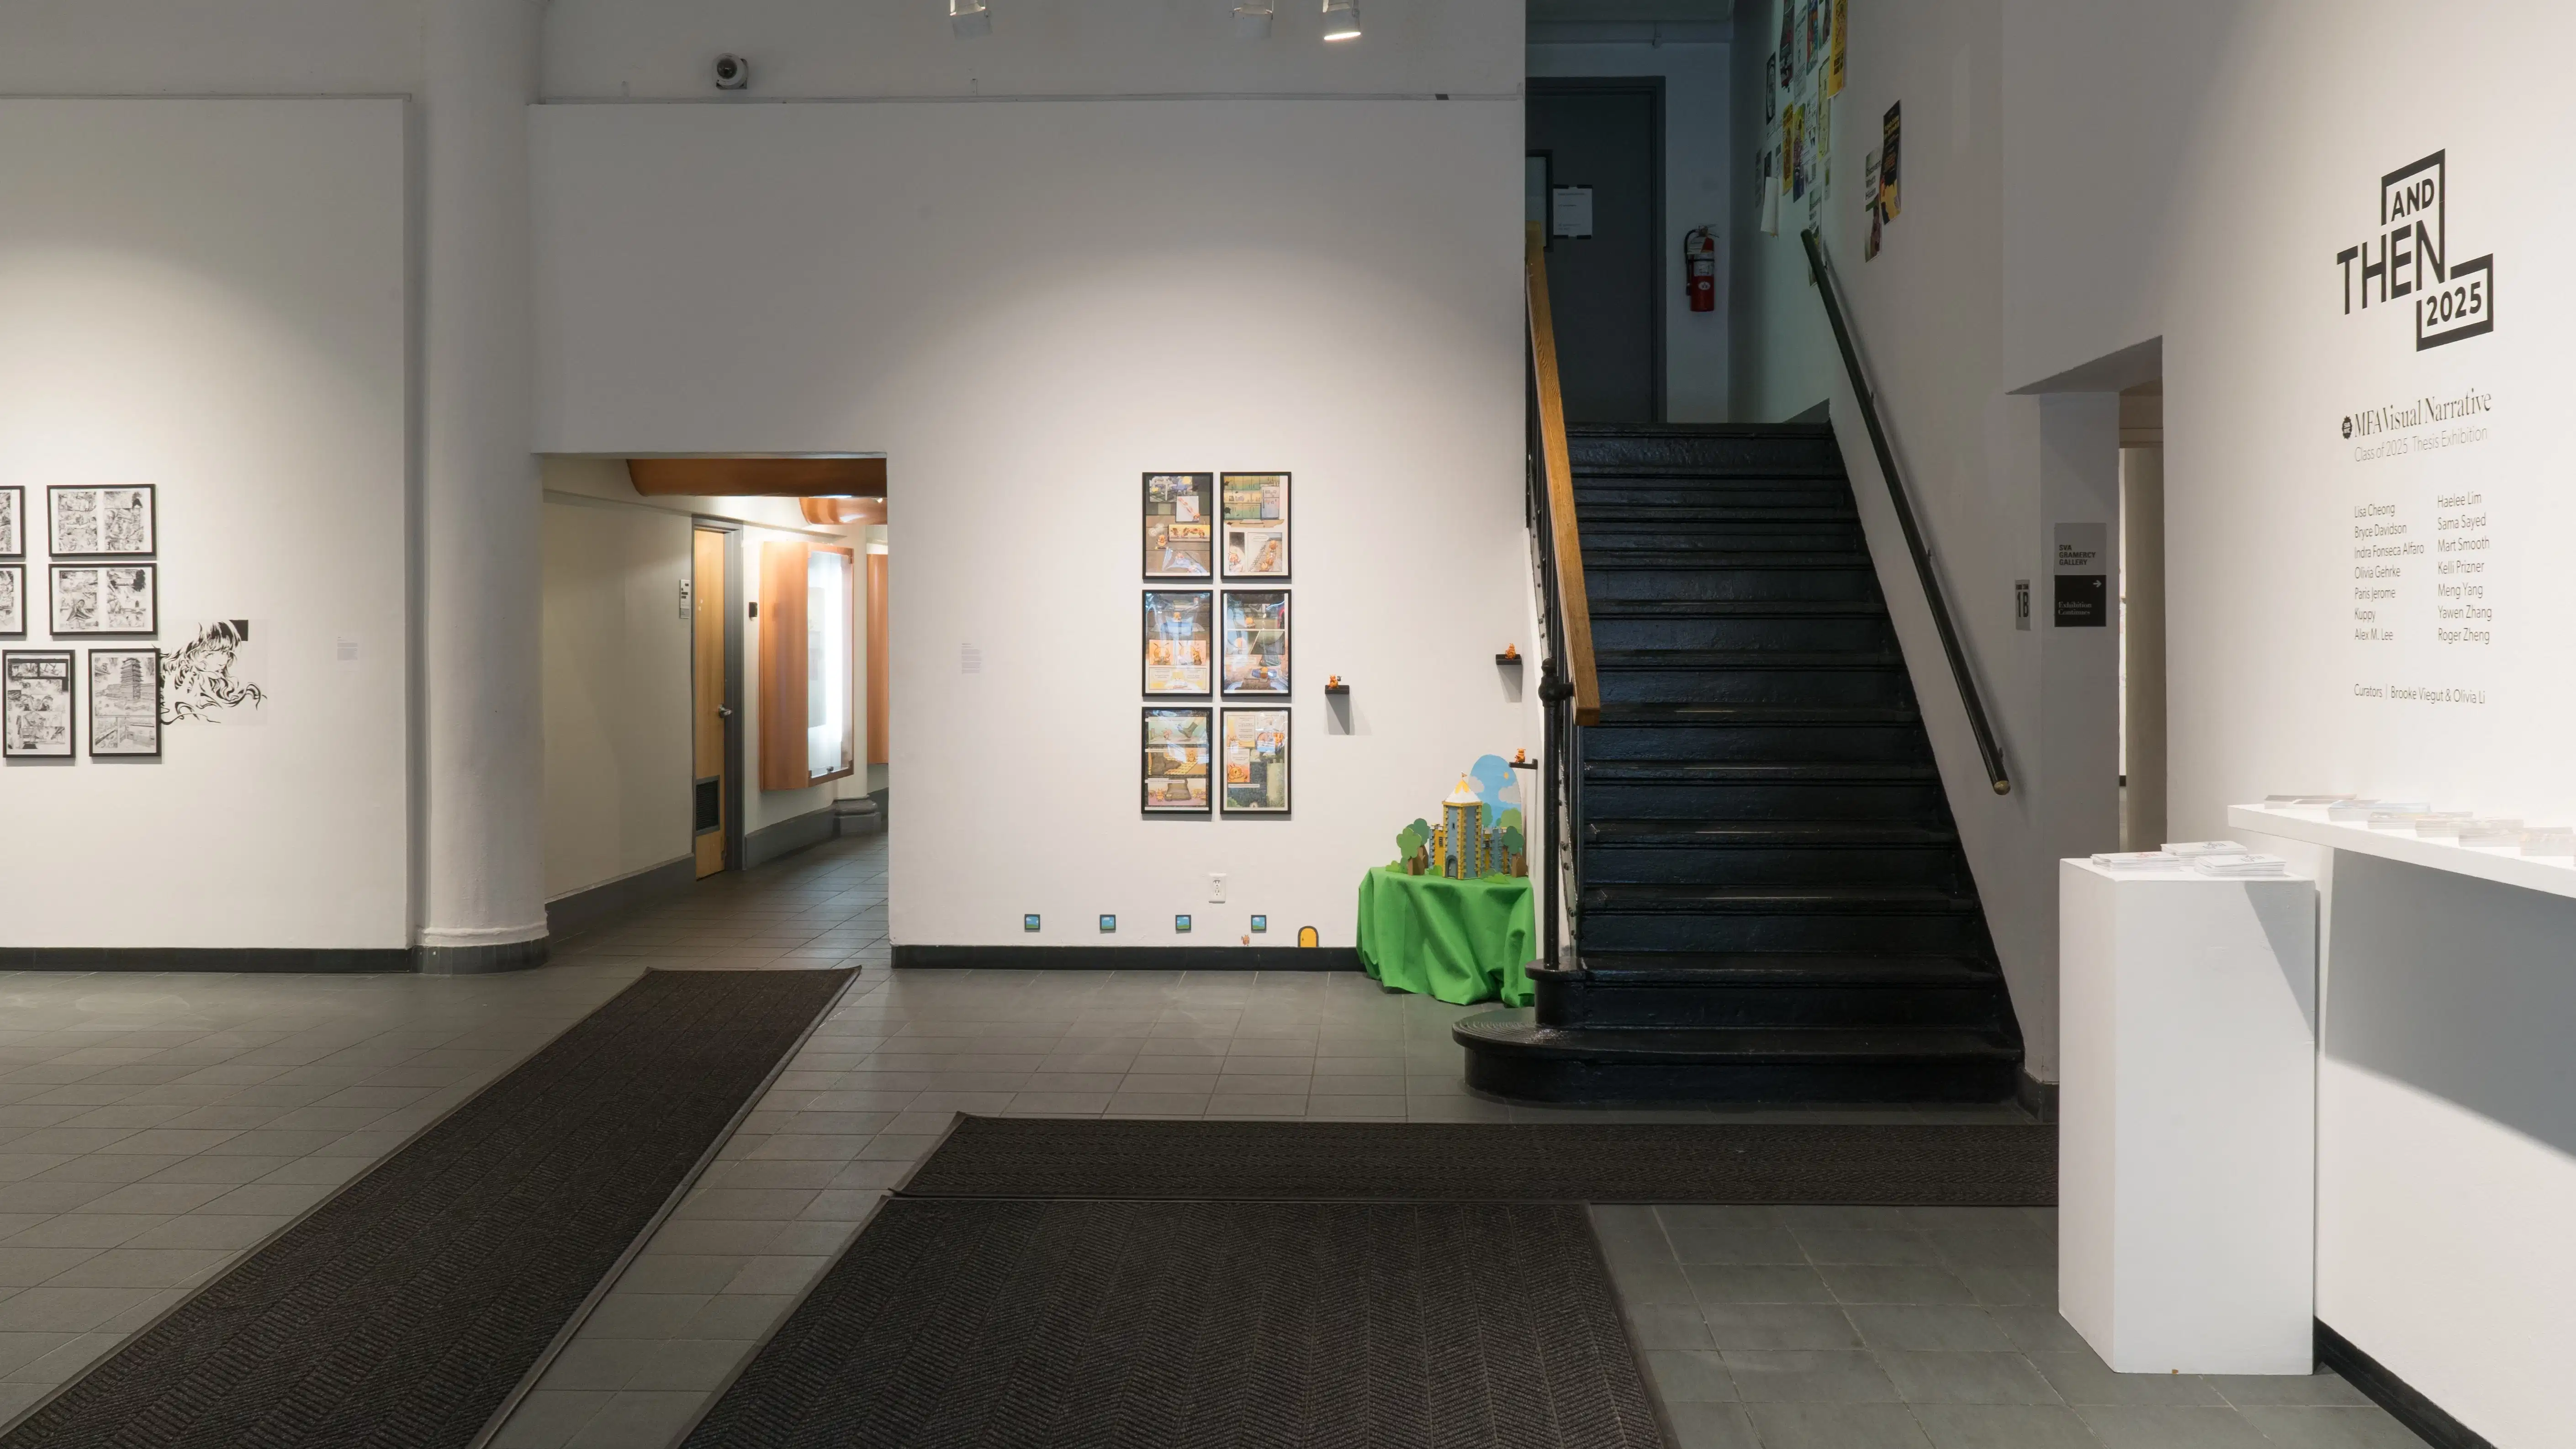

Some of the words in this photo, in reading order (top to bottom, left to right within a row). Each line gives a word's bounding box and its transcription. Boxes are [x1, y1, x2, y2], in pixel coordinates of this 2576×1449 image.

[2391, 178, 2434, 222] AND
[2337, 220, 2445, 315] THEN
[2426, 281, 2482, 327] 2025
[2354, 409, 2382, 438] MFA
[2382, 399, 2421, 430] Visual
[2424, 388, 2491, 423] Narrative
[2354, 446, 2375, 462] Class
[2376, 442, 2385, 458] of
[2386, 438, 2408, 457] 2025
[2412, 434, 2439, 452] Thesis
[2441, 426, 2488, 447] Exhibition
[2438, 493, 2465, 508] Haelee
[2467, 491, 2481, 505] Lim
[2354, 506, 2366, 518] Lisa
[2368, 503, 2395, 517] Cheong
[2438, 517, 2459, 530] Sama
[2461, 512, 2486, 531] Sayed
[2354, 526, 2373, 541] Bryce
[2375, 523, 2407, 536] Davidson
[2354, 546, 2371, 559] Indra
[2373, 545, 2401, 558] Fonseca
[2403, 542, 2424, 555] Alfaro
[2438, 539, 2456, 552] Mart
[2458, 535, 2490, 551] Smooth
[2354, 566, 2374, 579] Olivia
[2375, 565, 2401, 579] Gehrke
[2438, 561, 2454, 575] Kelli
[2456, 560, 2484, 573] Prizner
[2354, 587, 2370, 599] Paris
[2371, 587, 2396, 602] Jerome
[2438, 583, 2460, 599] Meng
[2462, 581, 2483, 598] Yang
[2354, 608, 2376, 623] Kuppy
[2438, 605, 2463, 619] Yawen
[2466, 605, 2492, 621] Zhang
[2354, 628, 2369, 640] Alex
[2370, 628, 2380, 640] M.
[2381, 628, 2393, 640] Lee
[2438, 628, 2461, 644] Roger
[2463, 628, 2490, 645] Zheng
[2354, 684, 2383, 698] Curators
[2391, 686, 2417, 699] Brooke
[2418, 687, 2443, 704] Viegut
[2445, 688, 2451, 702] &
[2453, 689, 2476, 703] Olivia
[2479, 691, 2485, 703] Li
